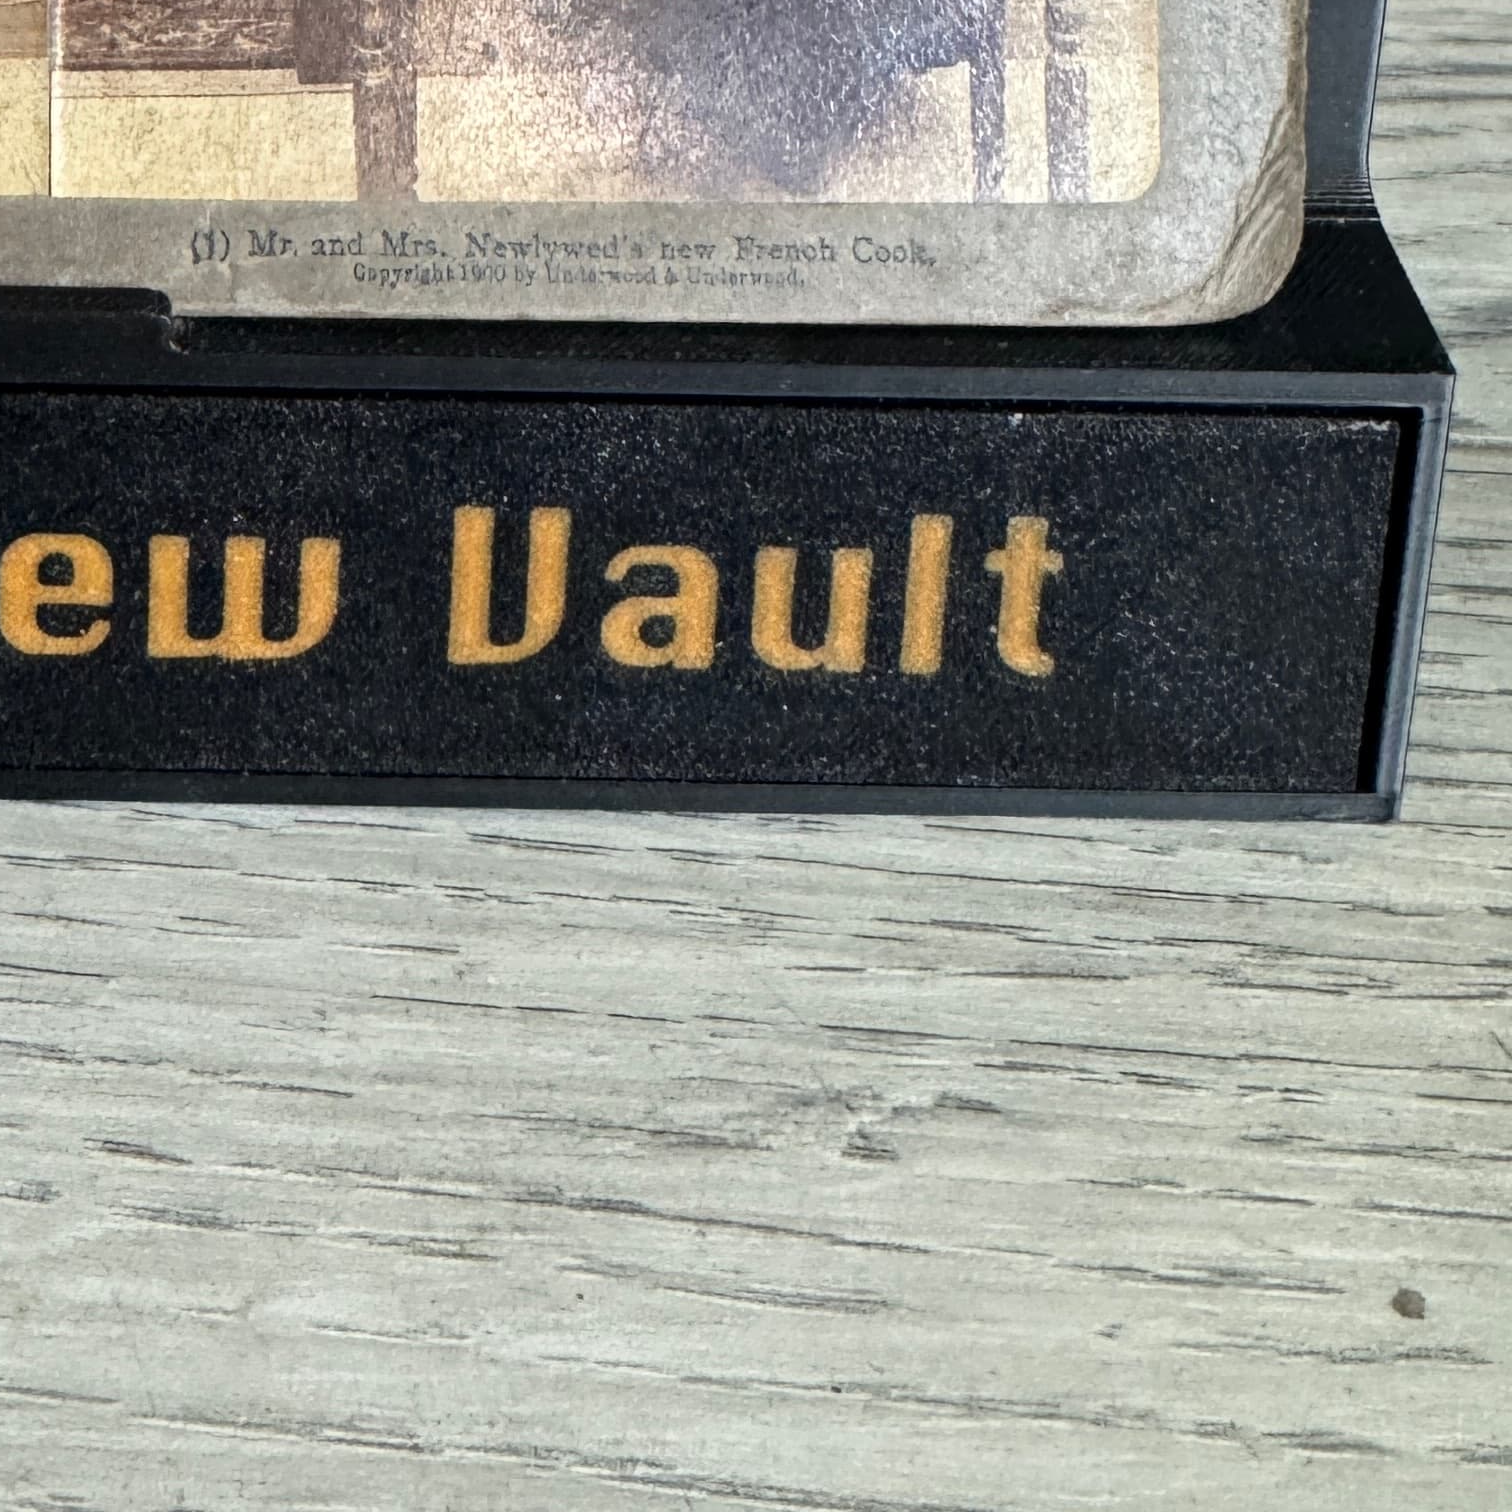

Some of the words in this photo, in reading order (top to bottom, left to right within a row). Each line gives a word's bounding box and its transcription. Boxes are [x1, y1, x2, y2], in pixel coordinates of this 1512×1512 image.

[311, 230, 364, 258] and
[382, 229, 447, 258] Mrs.
[659, 240, 717, 261] new
[734, 234, 837, 263] French
[514, 263, 536, 287] by
[446, 505, 1064, 677] Vault
